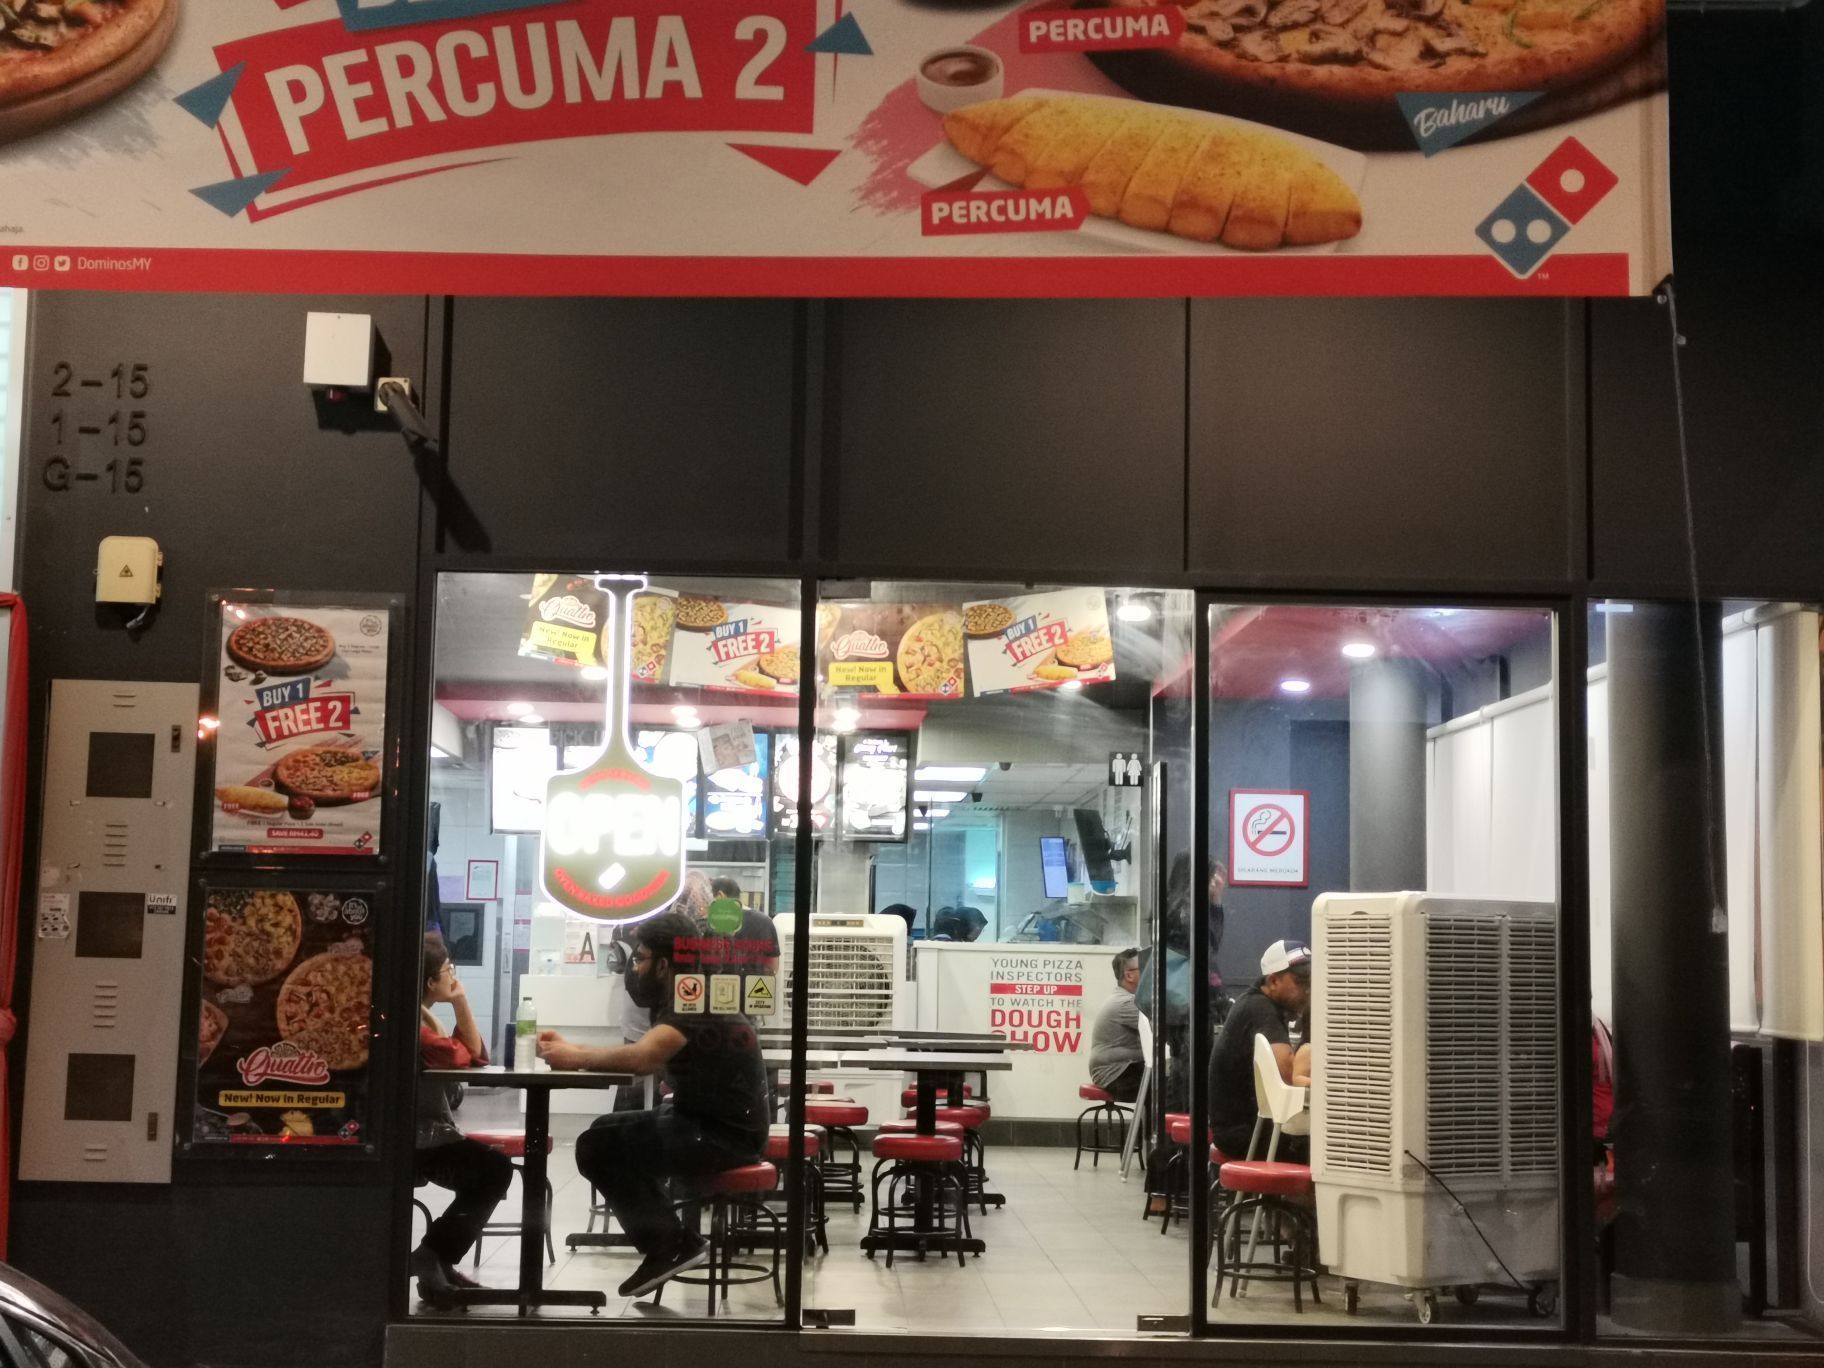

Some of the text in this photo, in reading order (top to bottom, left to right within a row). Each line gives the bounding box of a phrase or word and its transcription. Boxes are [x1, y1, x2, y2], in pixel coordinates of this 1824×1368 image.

[1029, 14, 1170, 43] PERCUMA
[264, 15, 787, 155] PERCUMA 2
[1413, 96, 1510, 137] Baharu
[931, 196, 1074, 225] PERCUMA
[77, 256, 151, 271] DominosMY
[52, 361, 149, 399] 2-15
[52, 410, 147, 447] 1-15
[43, 456, 144, 494] G-15
[539, 596, 596, 628] Quattro
[562, 631, 580, 641] Now
[716, 621, 744, 639] BUY 1
[1006, 618, 1035, 640] BUY 1
[717, 633, 771, 660] FREE 2
[830, 633, 889, 660] Quattro
[1011, 625, 1065, 661] FREE 2
[263, 682, 304, 707] BUY 1
[265, 701, 343, 739] FREE 2
[548, 791, 681, 857] OPEN
[580, 931, 595, 961] A
[990, 971, 1083, 983] INSPECTORS
[992, 958, 1084, 970] YOUNG PIZZA
[990, 997, 1083, 1009] TO WATCH THE
[1015, 984, 1058, 995] STEP UP
[991, 1009, 1081, 1029] DOUGH
[991, 1030, 1082, 1053] HOW
[238, 1045, 331, 1085] Quattro
[224, 1092, 341, 1106] New! Now in Regular
